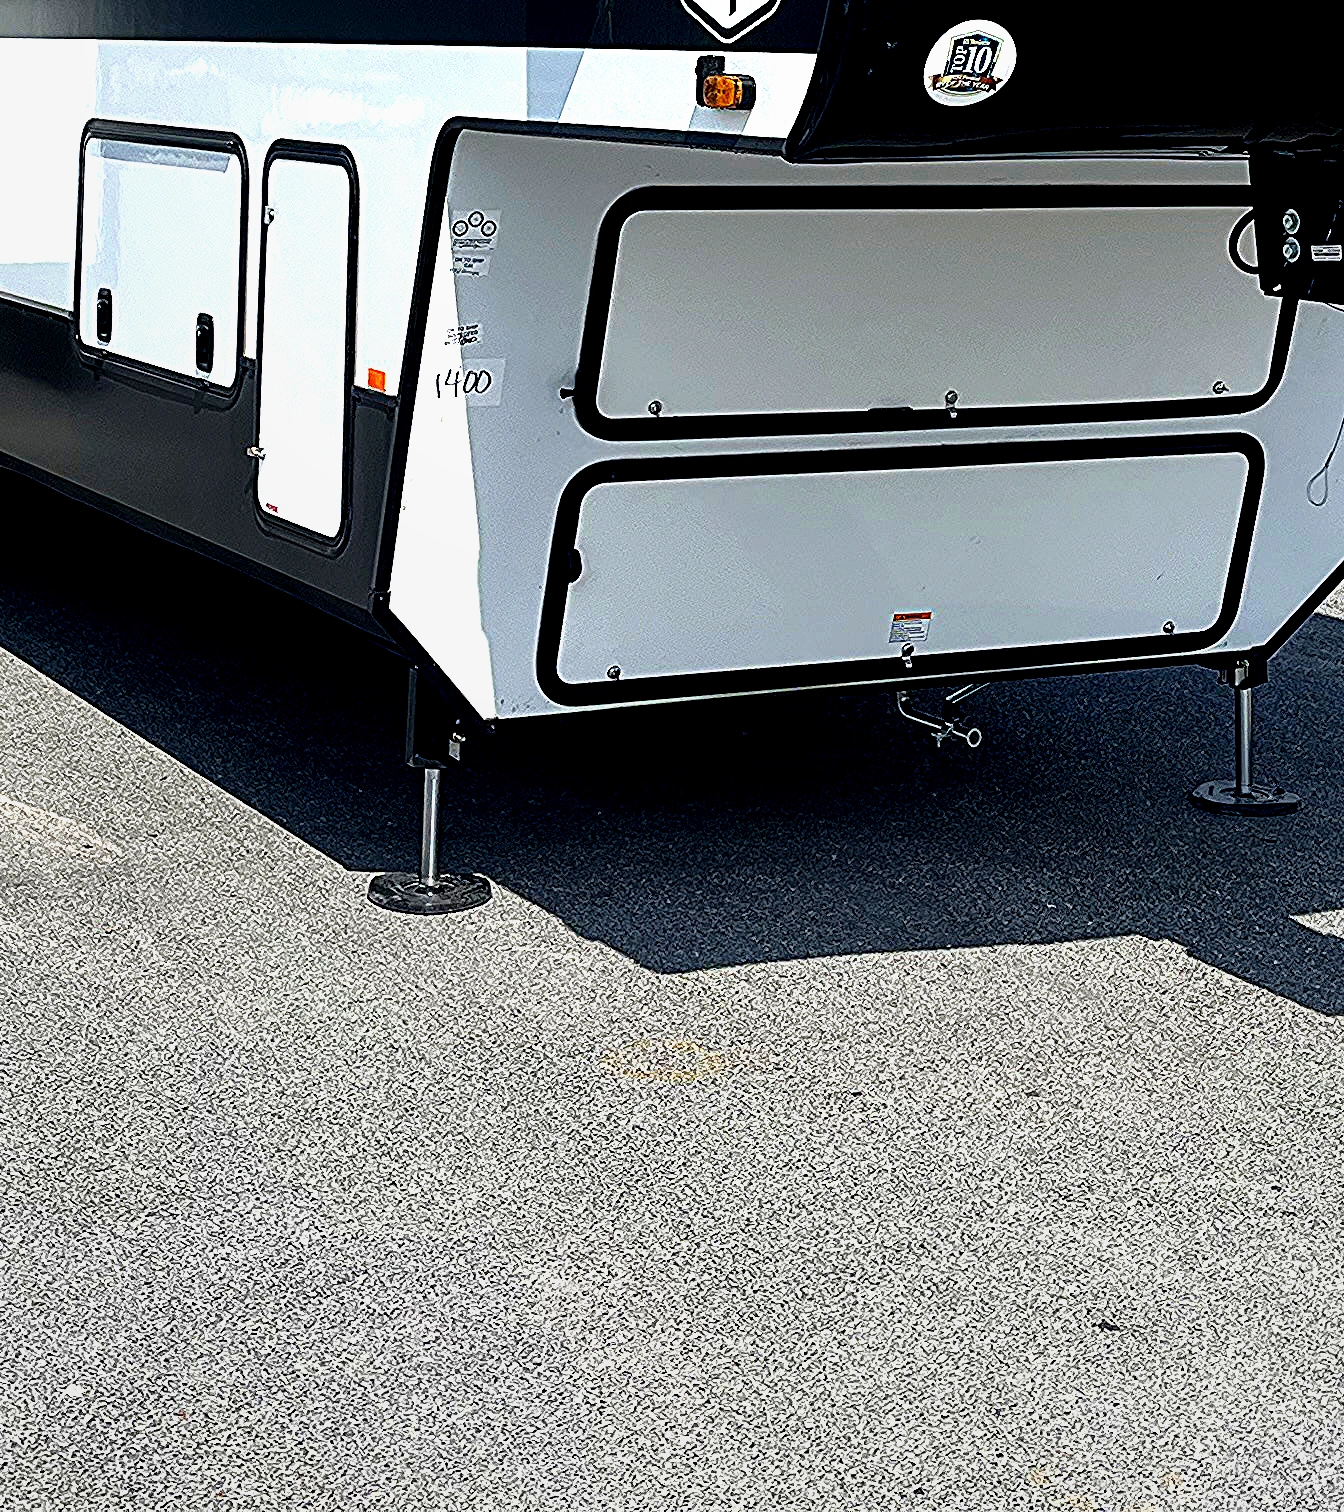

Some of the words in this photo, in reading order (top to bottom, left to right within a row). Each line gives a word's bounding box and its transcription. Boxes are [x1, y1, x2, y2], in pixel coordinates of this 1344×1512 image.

[950, 46, 967, 73] TOP
[962, 46, 993, 74] 10
[436, 369, 492, 399] 1400
